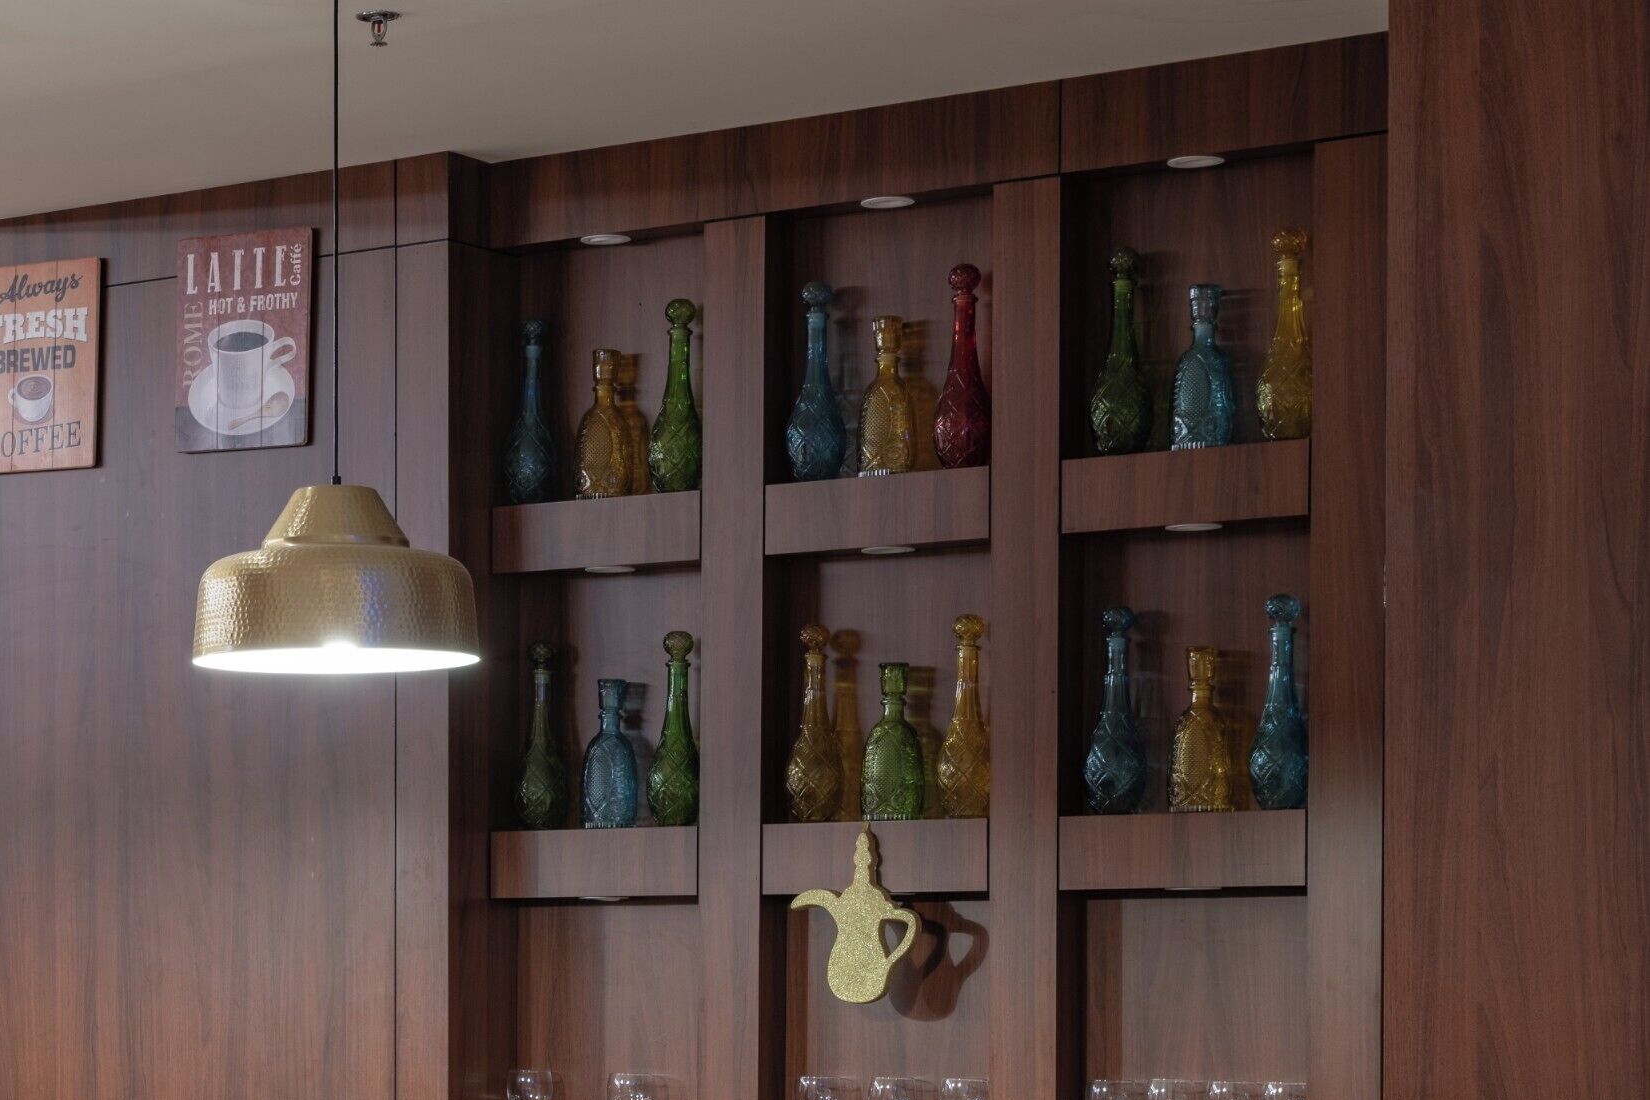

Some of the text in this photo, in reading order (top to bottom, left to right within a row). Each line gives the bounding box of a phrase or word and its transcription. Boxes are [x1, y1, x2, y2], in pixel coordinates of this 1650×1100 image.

[186, 245, 287, 295] LATTE
[290, 243, 303, 286] Caffé
[208, 292, 298, 315] HOT & FROTHY
[182, 301, 203, 388] ROME
